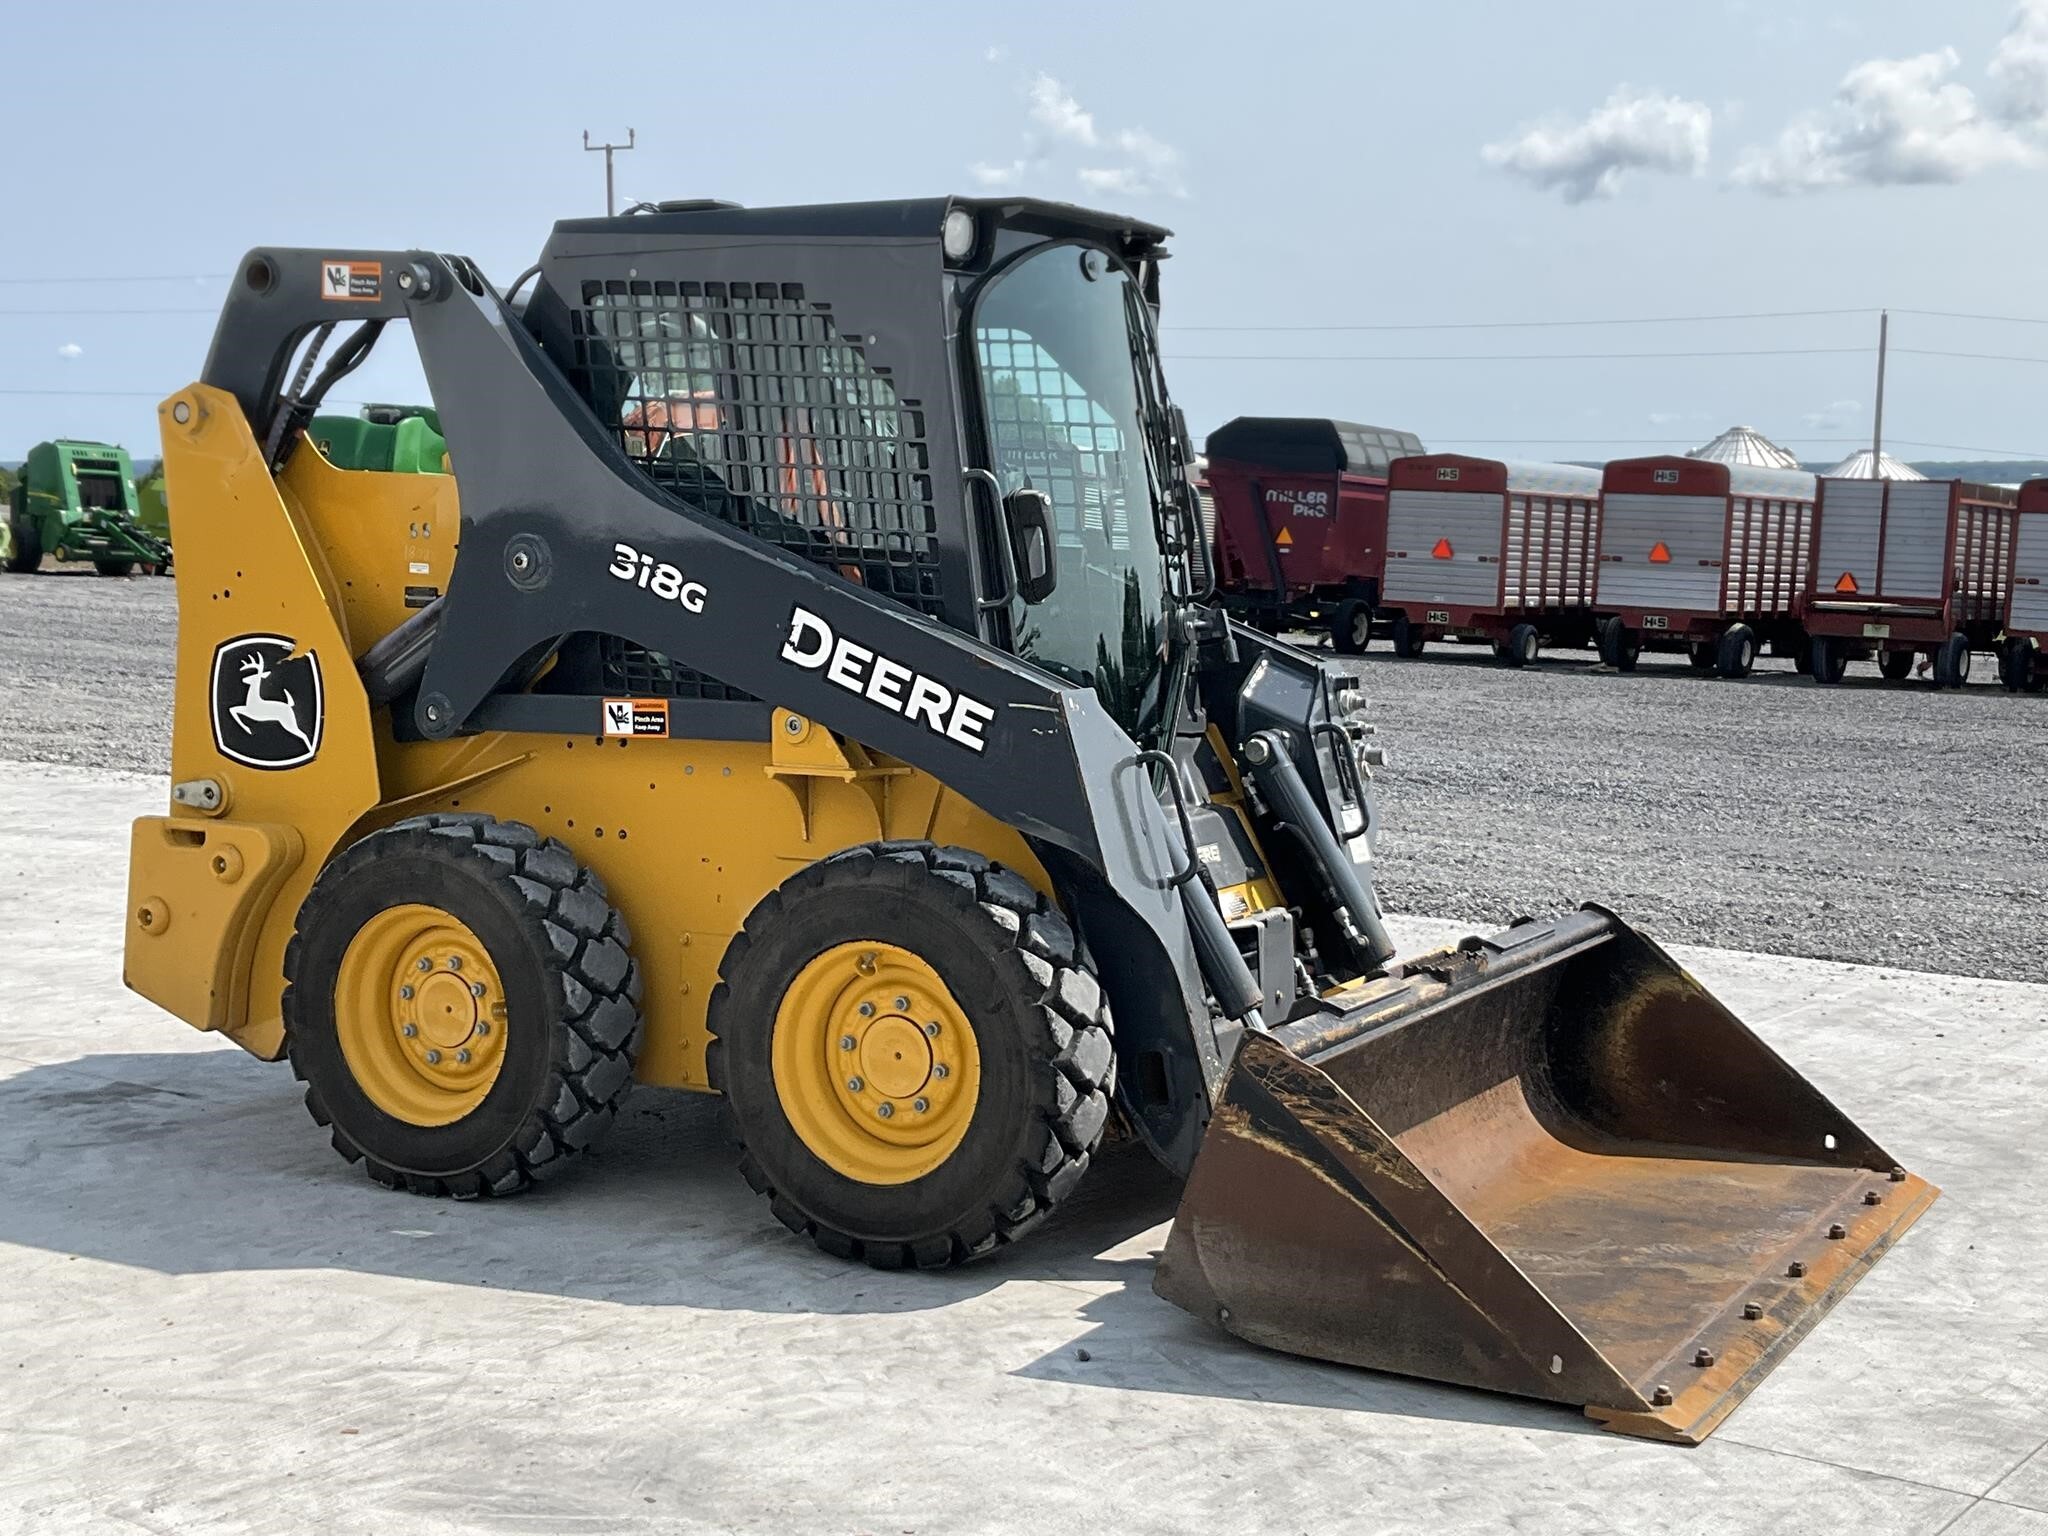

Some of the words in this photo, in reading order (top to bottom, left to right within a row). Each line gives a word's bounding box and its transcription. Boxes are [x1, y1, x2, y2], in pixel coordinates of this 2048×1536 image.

[1265, 489, 1328, 504] MILLER
[1293, 504, 1328, 518] PRO
[609, 543, 708, 614] 318G
[781, 607, 995, 752] DEERE
